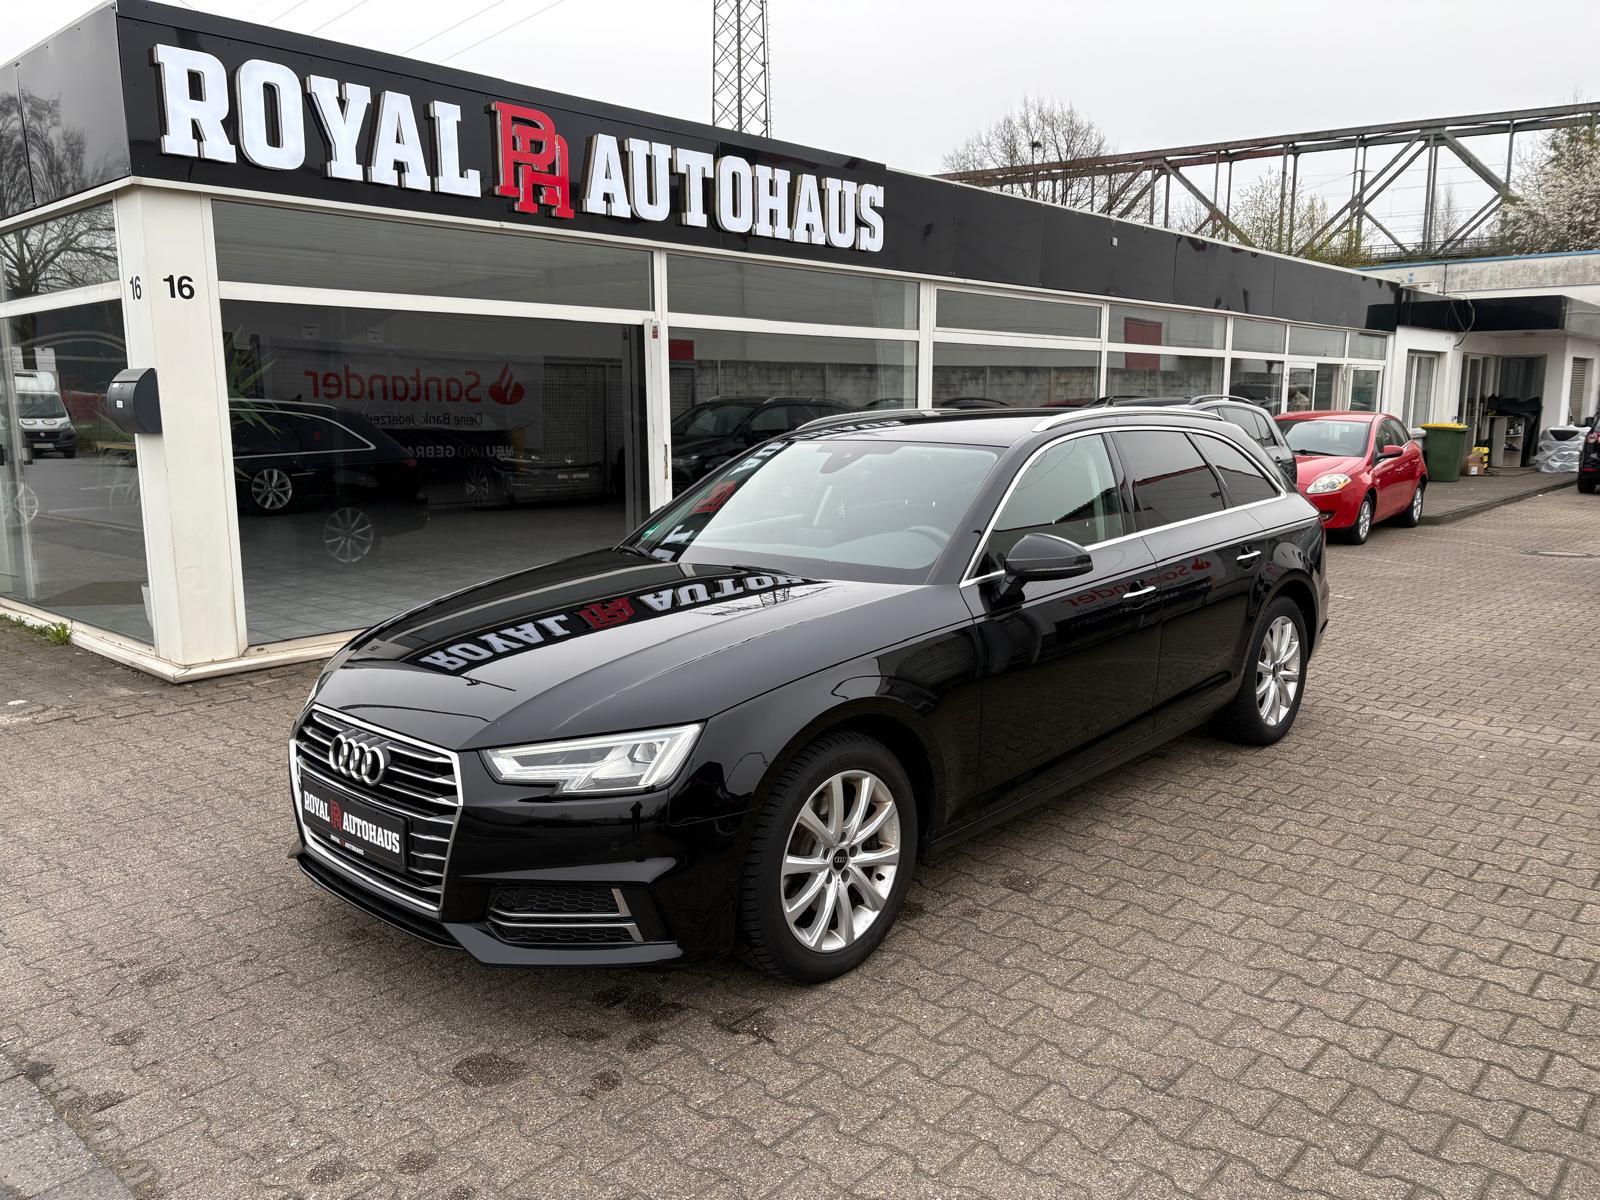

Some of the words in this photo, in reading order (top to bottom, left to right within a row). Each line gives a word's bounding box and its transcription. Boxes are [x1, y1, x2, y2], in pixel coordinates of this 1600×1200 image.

[153, 43, 481, 198] ROYAL
[582, 133, 884, 253] AUTOHAUS
[129, 275, 142, 301] 16
[163, 274, 195, 300] 16
[303, 790, 330, 822] ROYAL
[342, 811, 400, 854] AUTOHAUS
